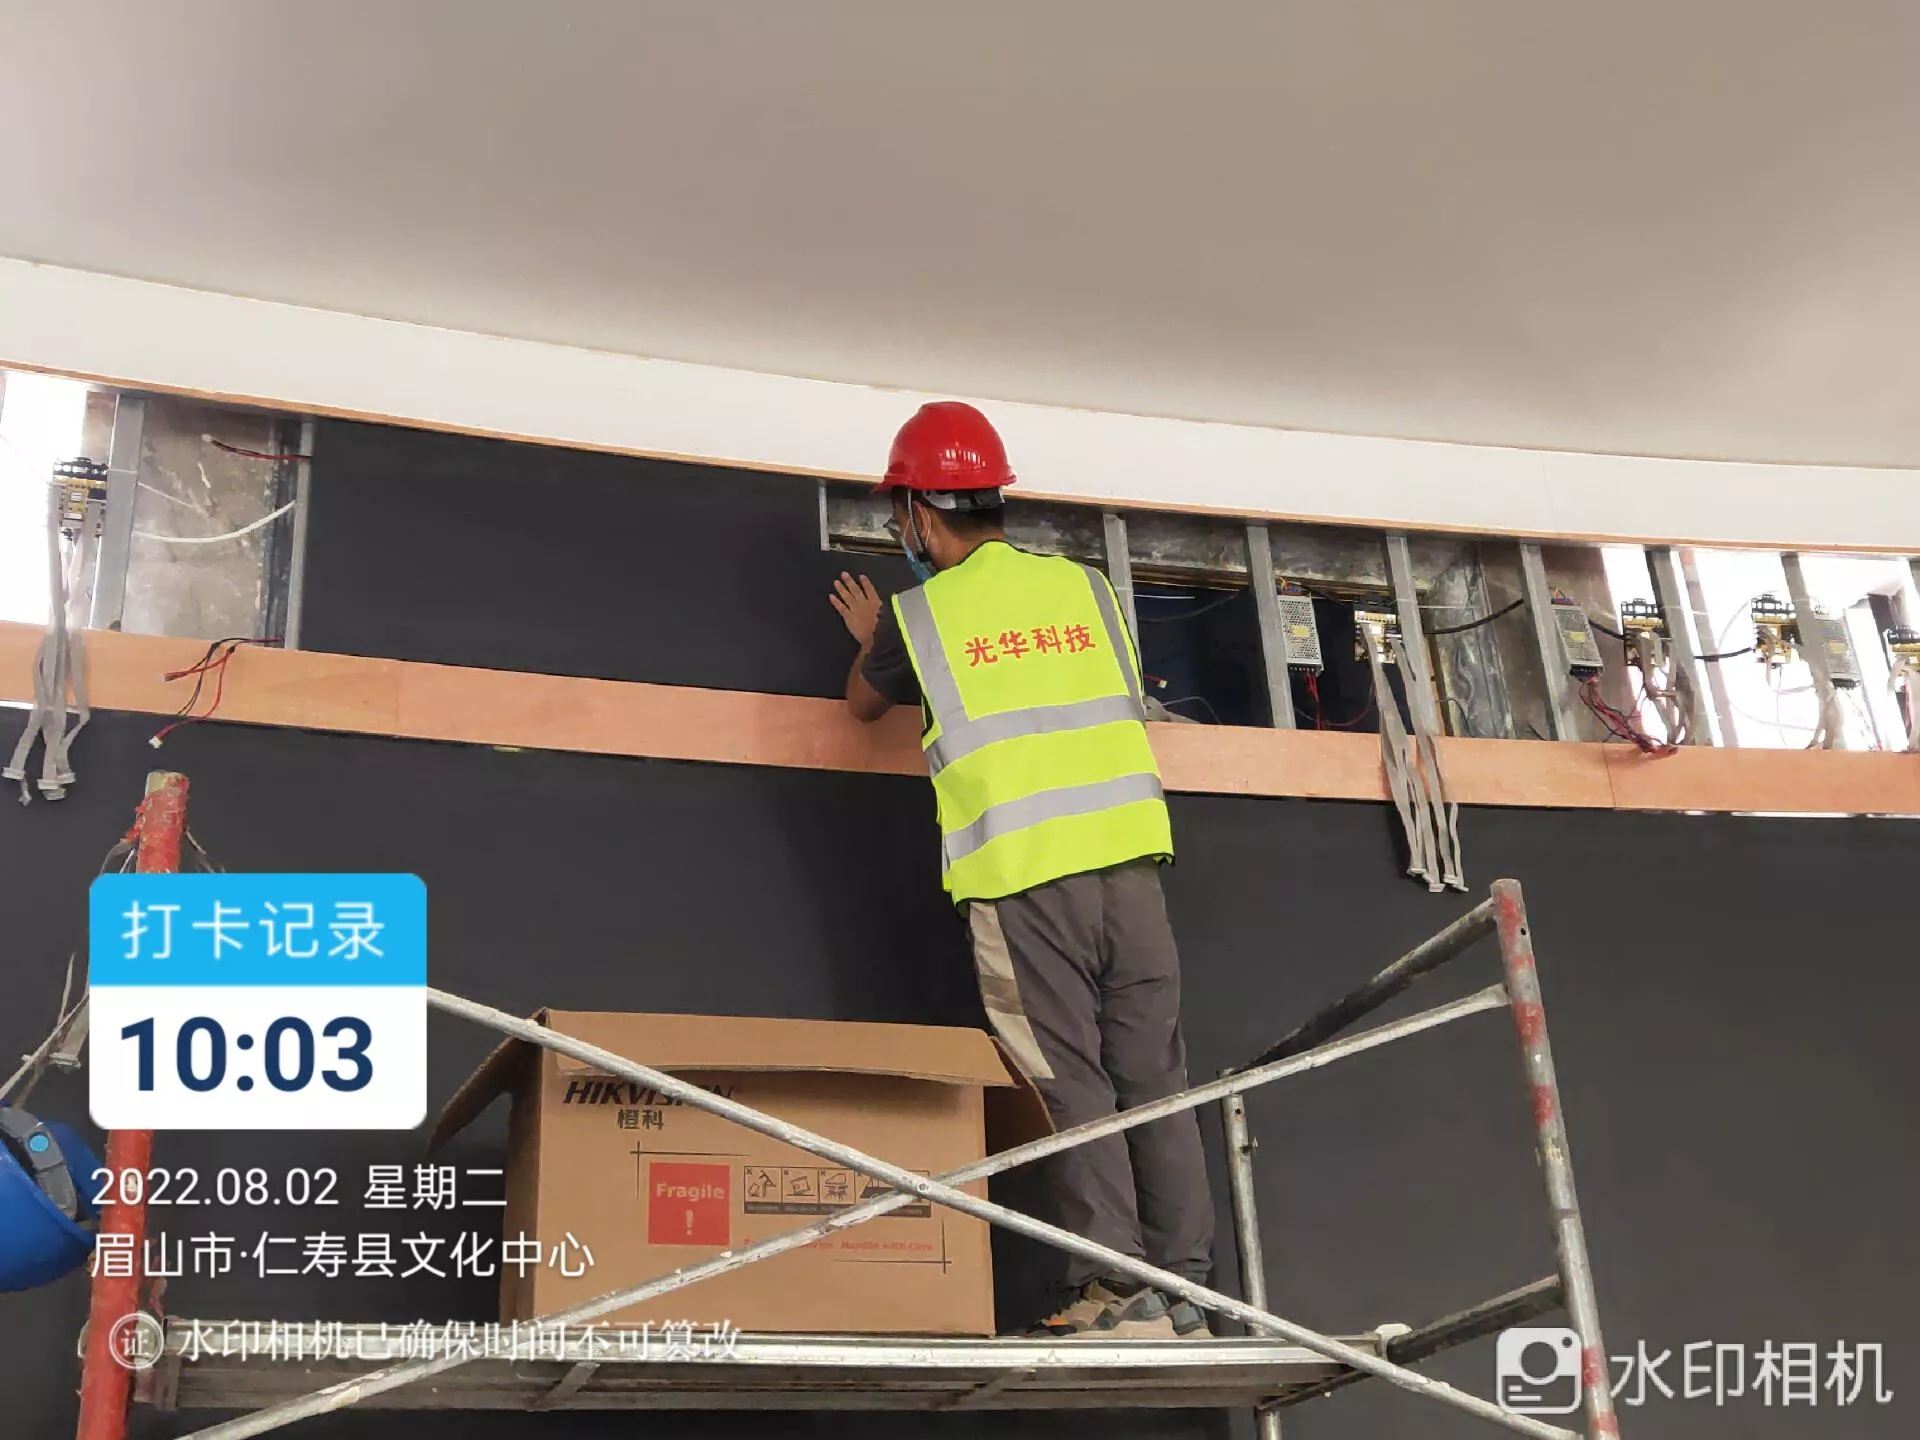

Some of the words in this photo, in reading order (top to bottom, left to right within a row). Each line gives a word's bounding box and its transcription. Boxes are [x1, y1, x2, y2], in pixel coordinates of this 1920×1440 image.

[965, 624, 1096, 667] 光华科技
[563, 1080, 734, 1105] HIKVIN
[656, 1183, 725, 1202] Fragile
